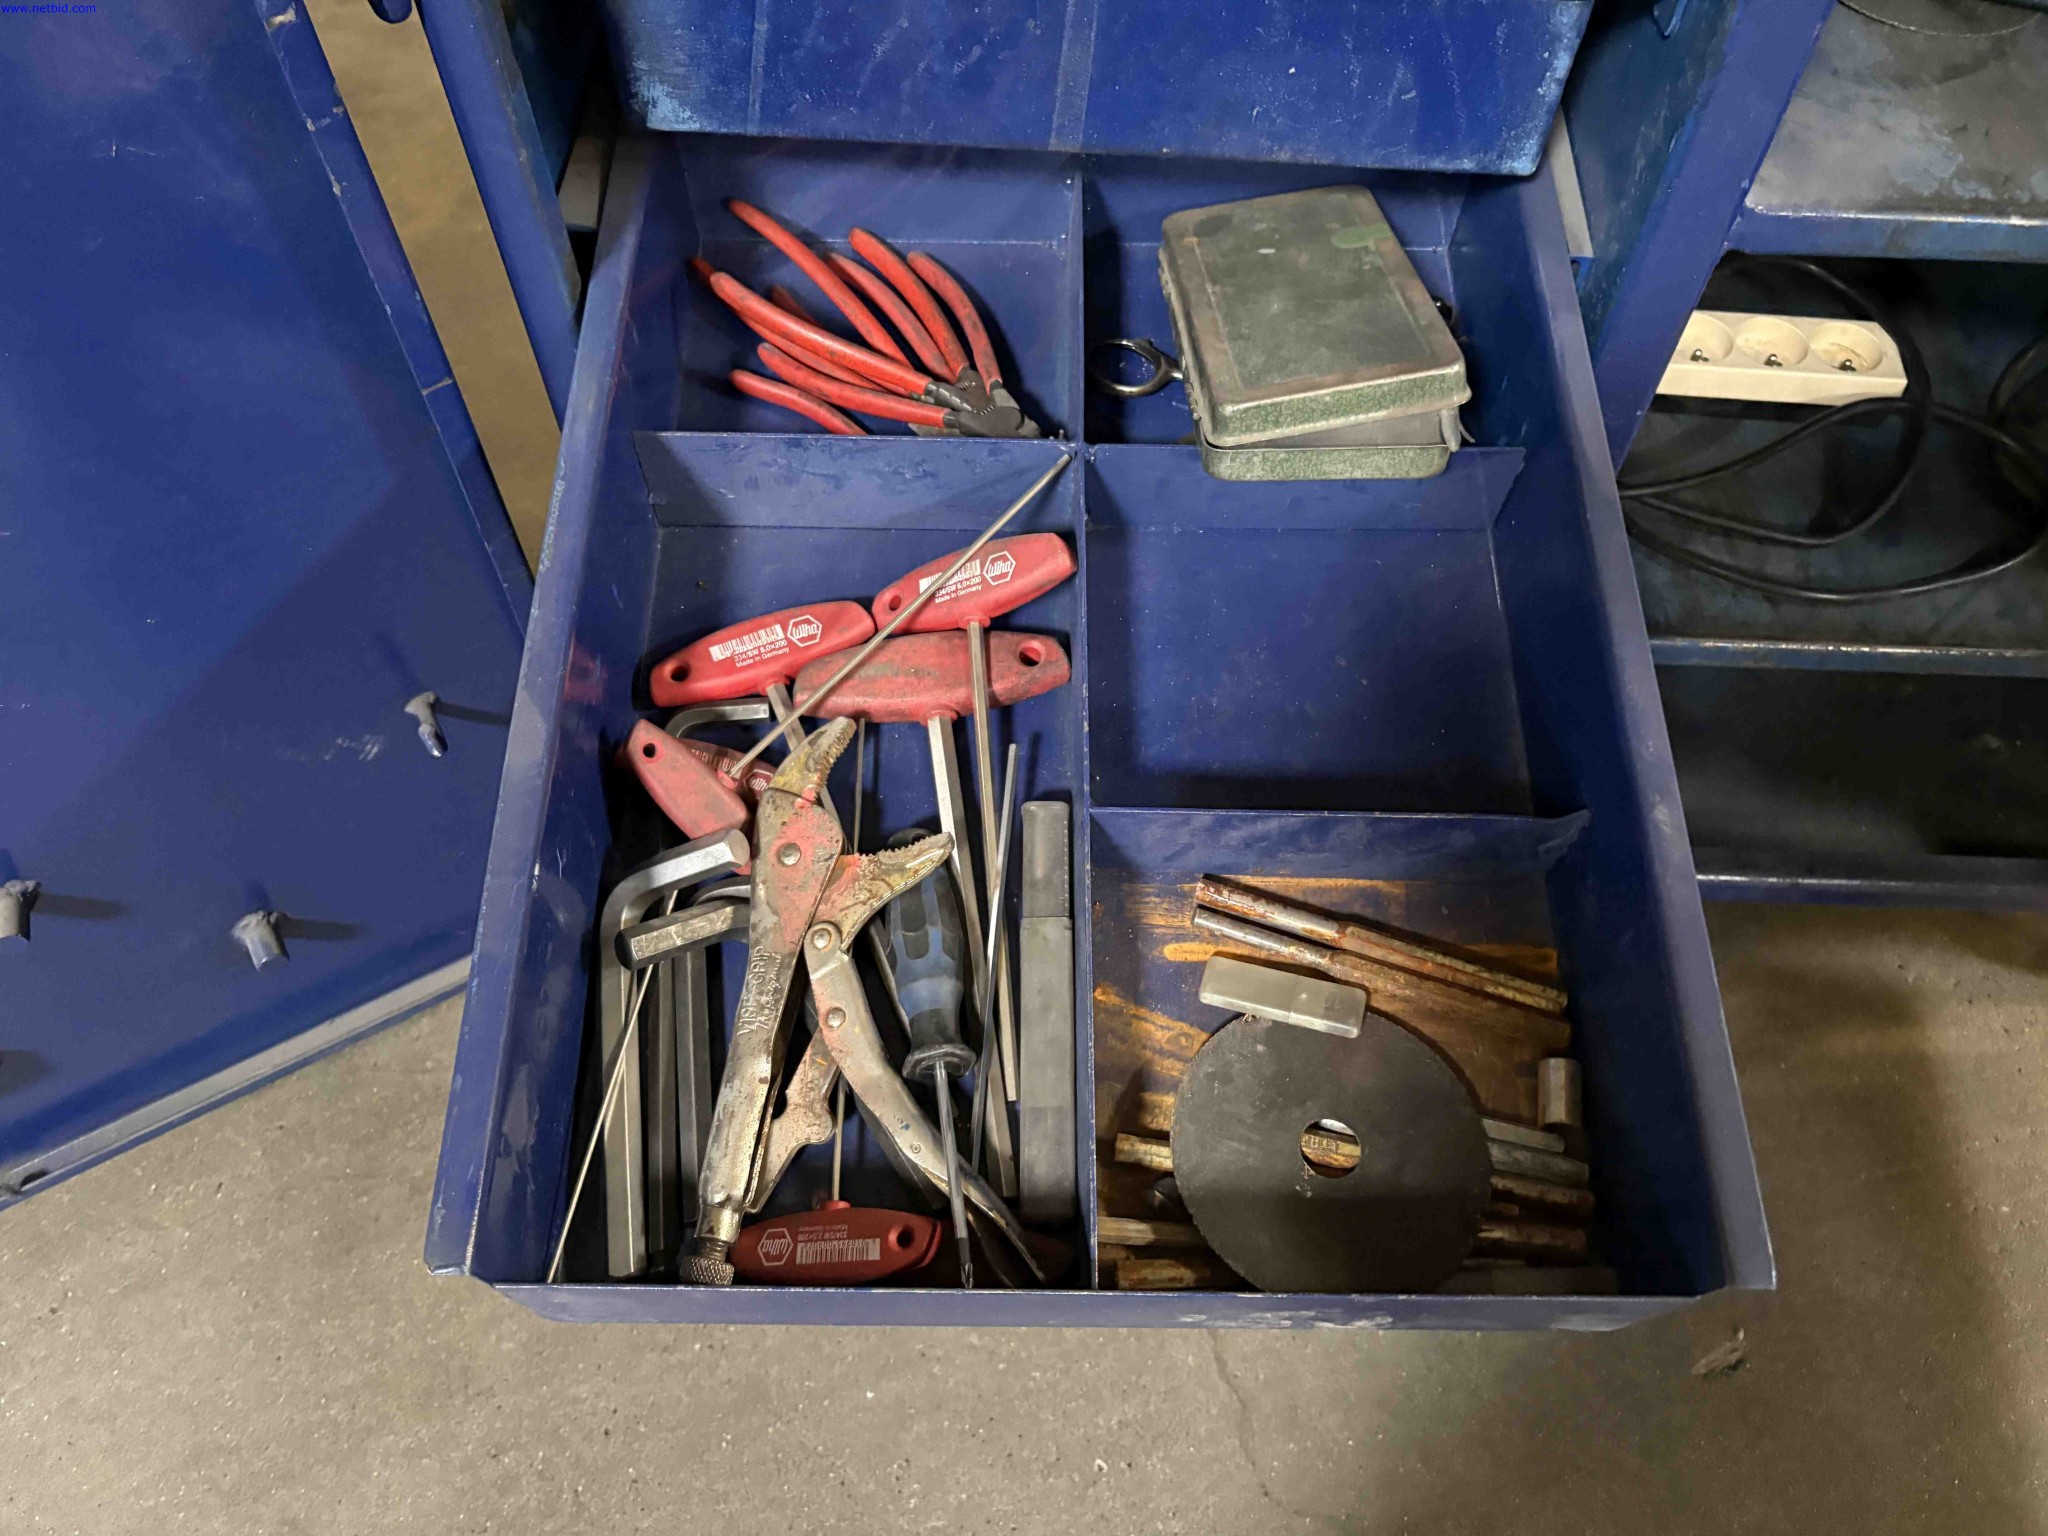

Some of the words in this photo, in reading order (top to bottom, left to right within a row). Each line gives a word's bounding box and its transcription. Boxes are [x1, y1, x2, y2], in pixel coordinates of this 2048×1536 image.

[988, 559, 1011, 577] Wiha
[935, 594, 950, 604] Made
[957, 584, 982, 596] Germany
[792, 623, 819, 639] Wiha
[734, 648, 759, 662] 334/SW
[736, 658, 754, 668] Made
[762, 647, 790, 659] Germany
[762, 1238, 788, 1256] Wiha
